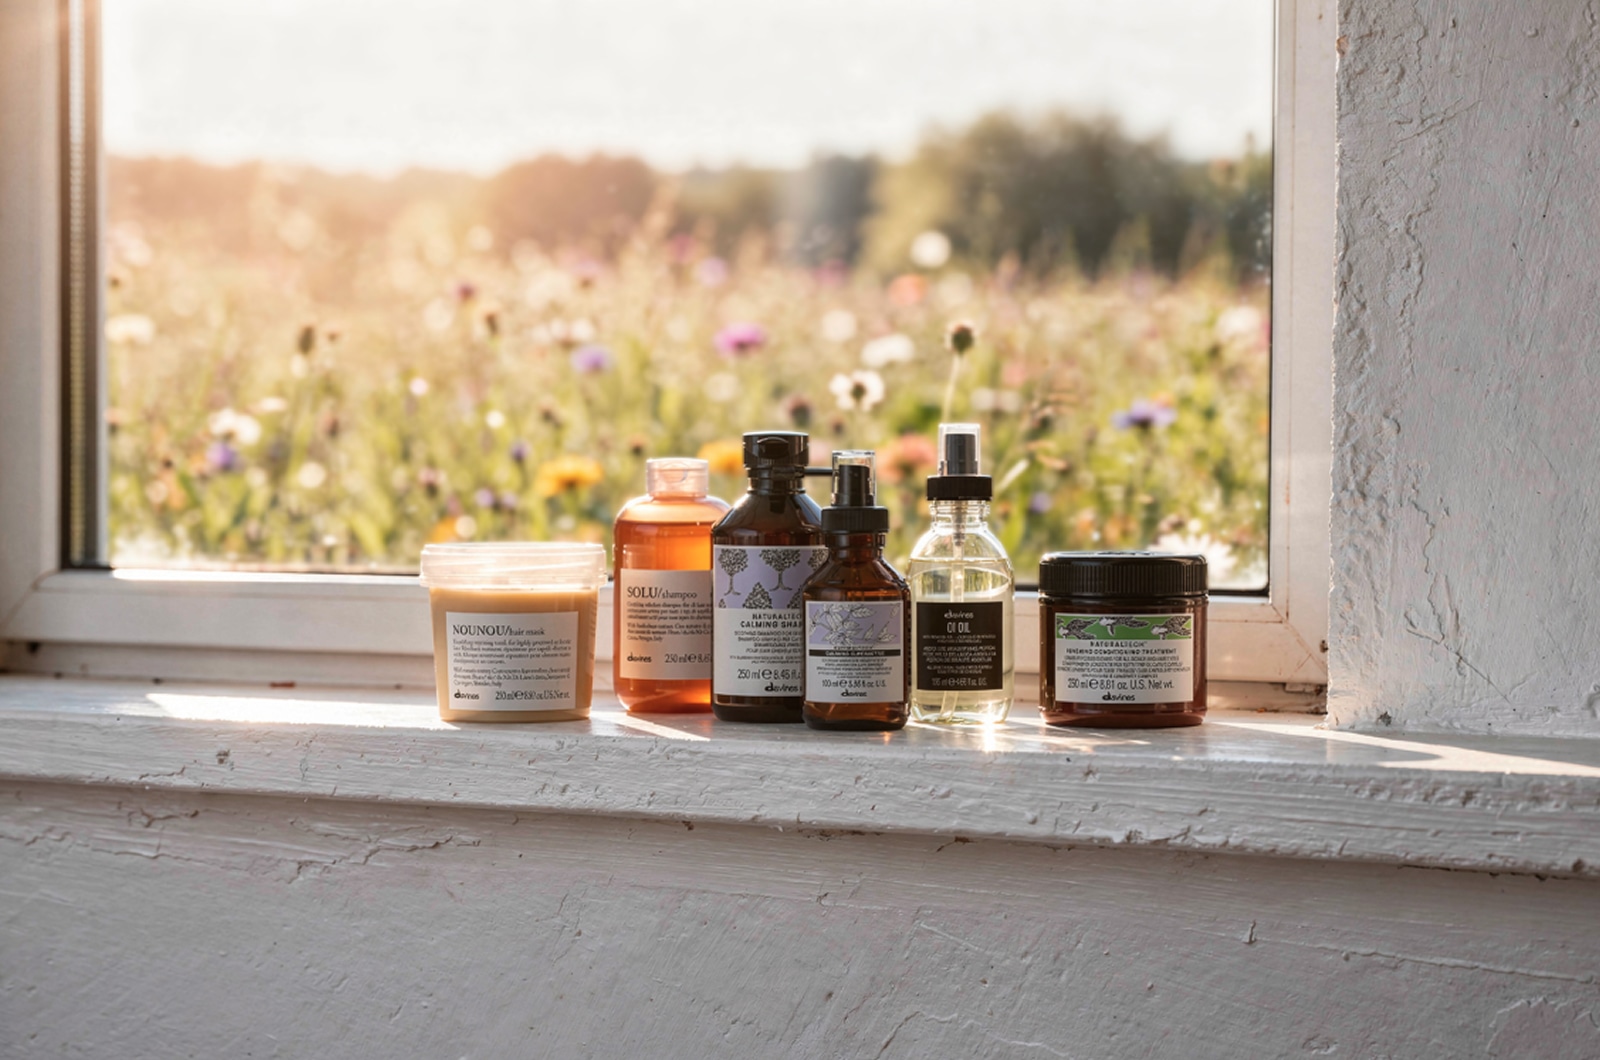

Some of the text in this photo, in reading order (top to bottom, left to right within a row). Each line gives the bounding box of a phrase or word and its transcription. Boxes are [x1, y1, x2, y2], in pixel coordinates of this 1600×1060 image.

[526, 628, 545, 636] mask
[958, 622, 971, 633] OIL
[737, 669, 751, 680] 250
[752, 669, 760, 679] ml
[1068, 678, 1080, 689] 250
[1130, 678, 1147, 690] U.S.
